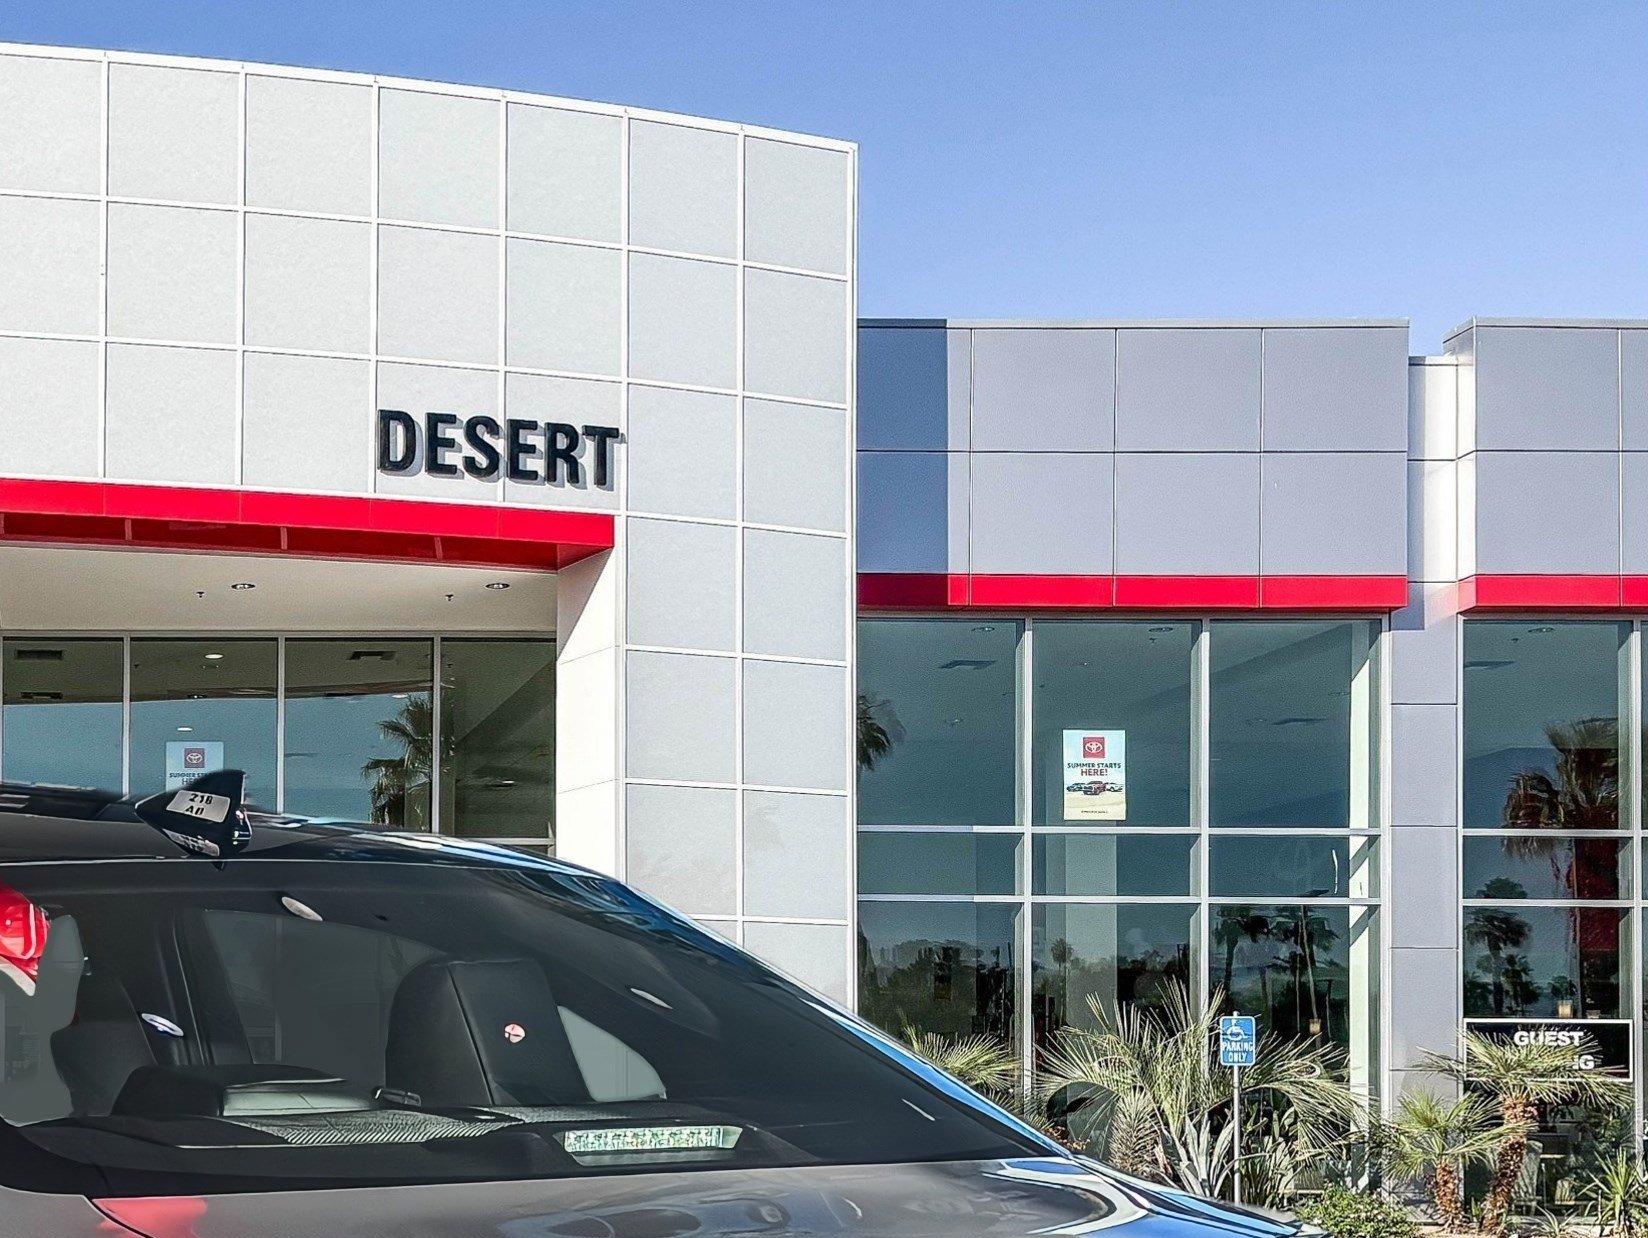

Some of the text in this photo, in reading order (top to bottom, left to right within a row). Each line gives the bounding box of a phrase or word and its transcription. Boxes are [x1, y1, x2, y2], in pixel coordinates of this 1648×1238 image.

[377, 409, 620, 487] DESERT
[1514, 1031, 1584, 1047] GUEST
[1222, 1041, 1253, 1051] PARKING
[1228, 1051, 1248, 1062] ONLY
